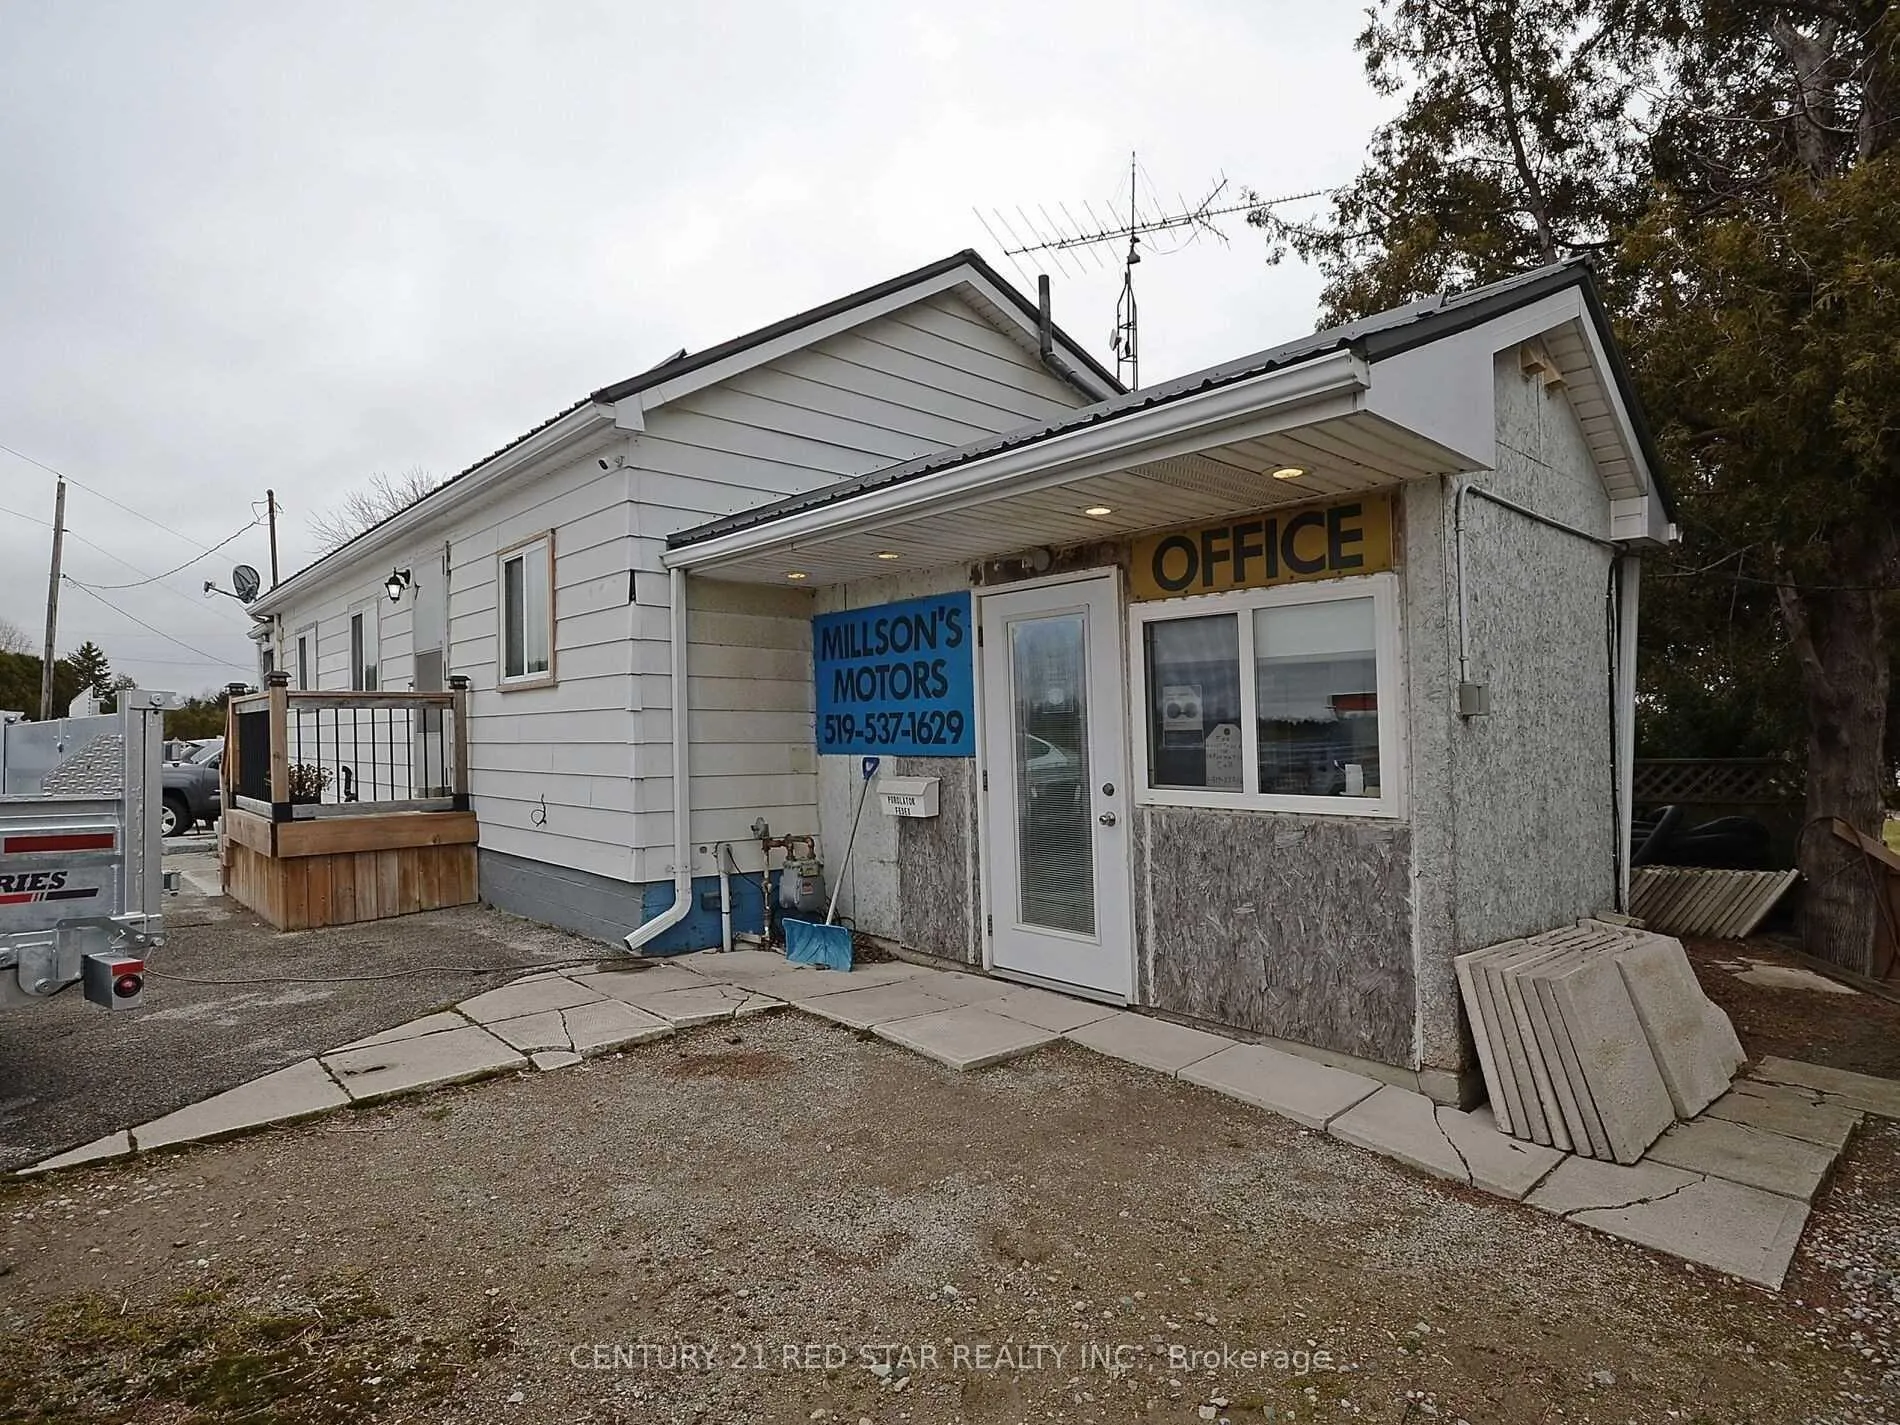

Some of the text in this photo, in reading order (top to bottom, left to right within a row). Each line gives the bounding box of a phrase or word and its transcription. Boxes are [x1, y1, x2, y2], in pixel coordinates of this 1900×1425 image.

[1152, 503, 1364, 592] OFFICE
[821, 605, 963, 662] MILLSON'S
[832, 658, 949, 704] MOTORS
[824, 709, 964, 745] 519-537-1629
